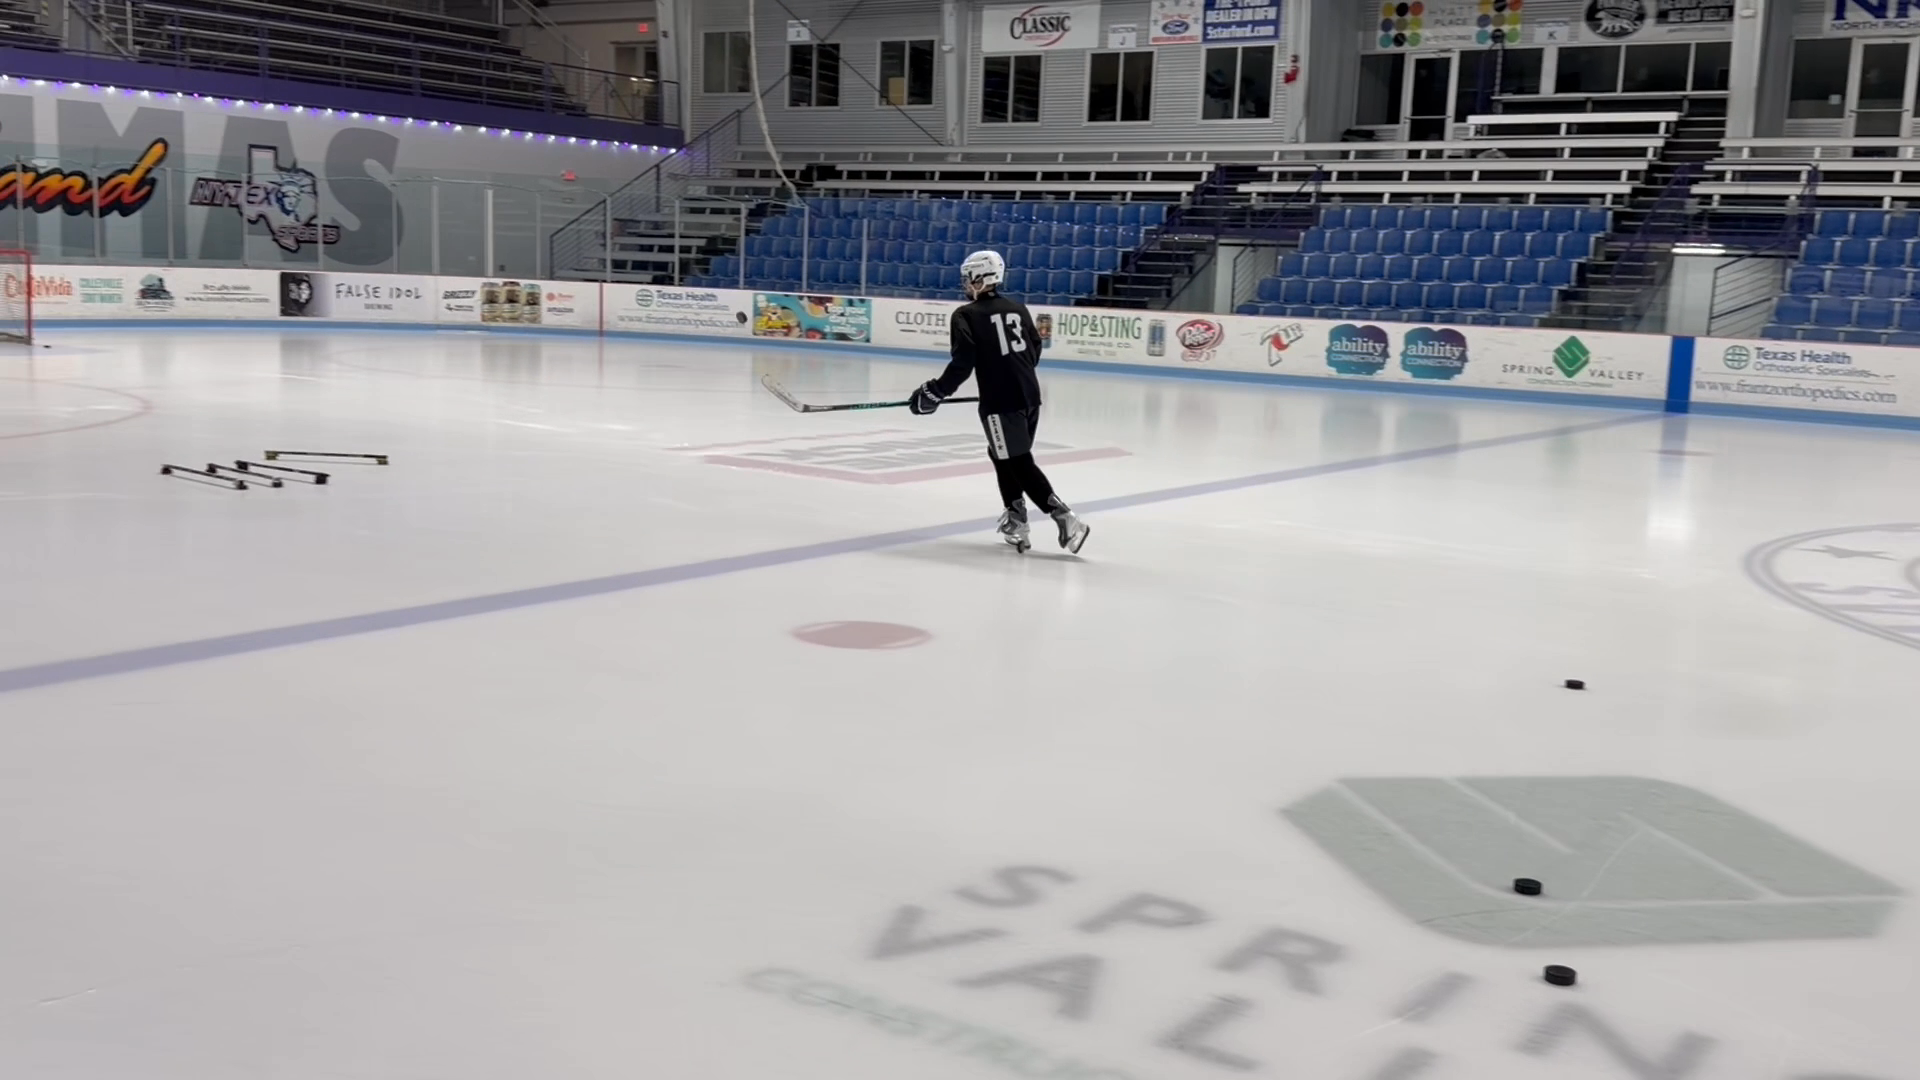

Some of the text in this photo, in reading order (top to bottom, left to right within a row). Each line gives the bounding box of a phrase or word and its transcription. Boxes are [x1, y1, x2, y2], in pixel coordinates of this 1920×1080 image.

[1010, 15, 1071, 40] CLASSIC
[335, 282, 422, 299] FALSE IDOL
[655, 289, 718, 303] Texas Health
[895, 310, 948, 327] CLOTH
[1057, 312, 1143, 340] HOP&STING
[989, 312, 1027, 356] 13
[1332, 336, 1386, 359] ability
[1407, 341, 1464, 362] ability
[1754, 346, 1853, 365] Texas Health
[1331, 353, 1385, 363] CONNECTION
[1406, 357, 1462, 367] CONNECTION
[1502, 363, 1645, 381] SPRING VALLEY
[1753, 360, 1813, 375] Orthopedic
[950, 864, 1750, 1080] SPRIN
